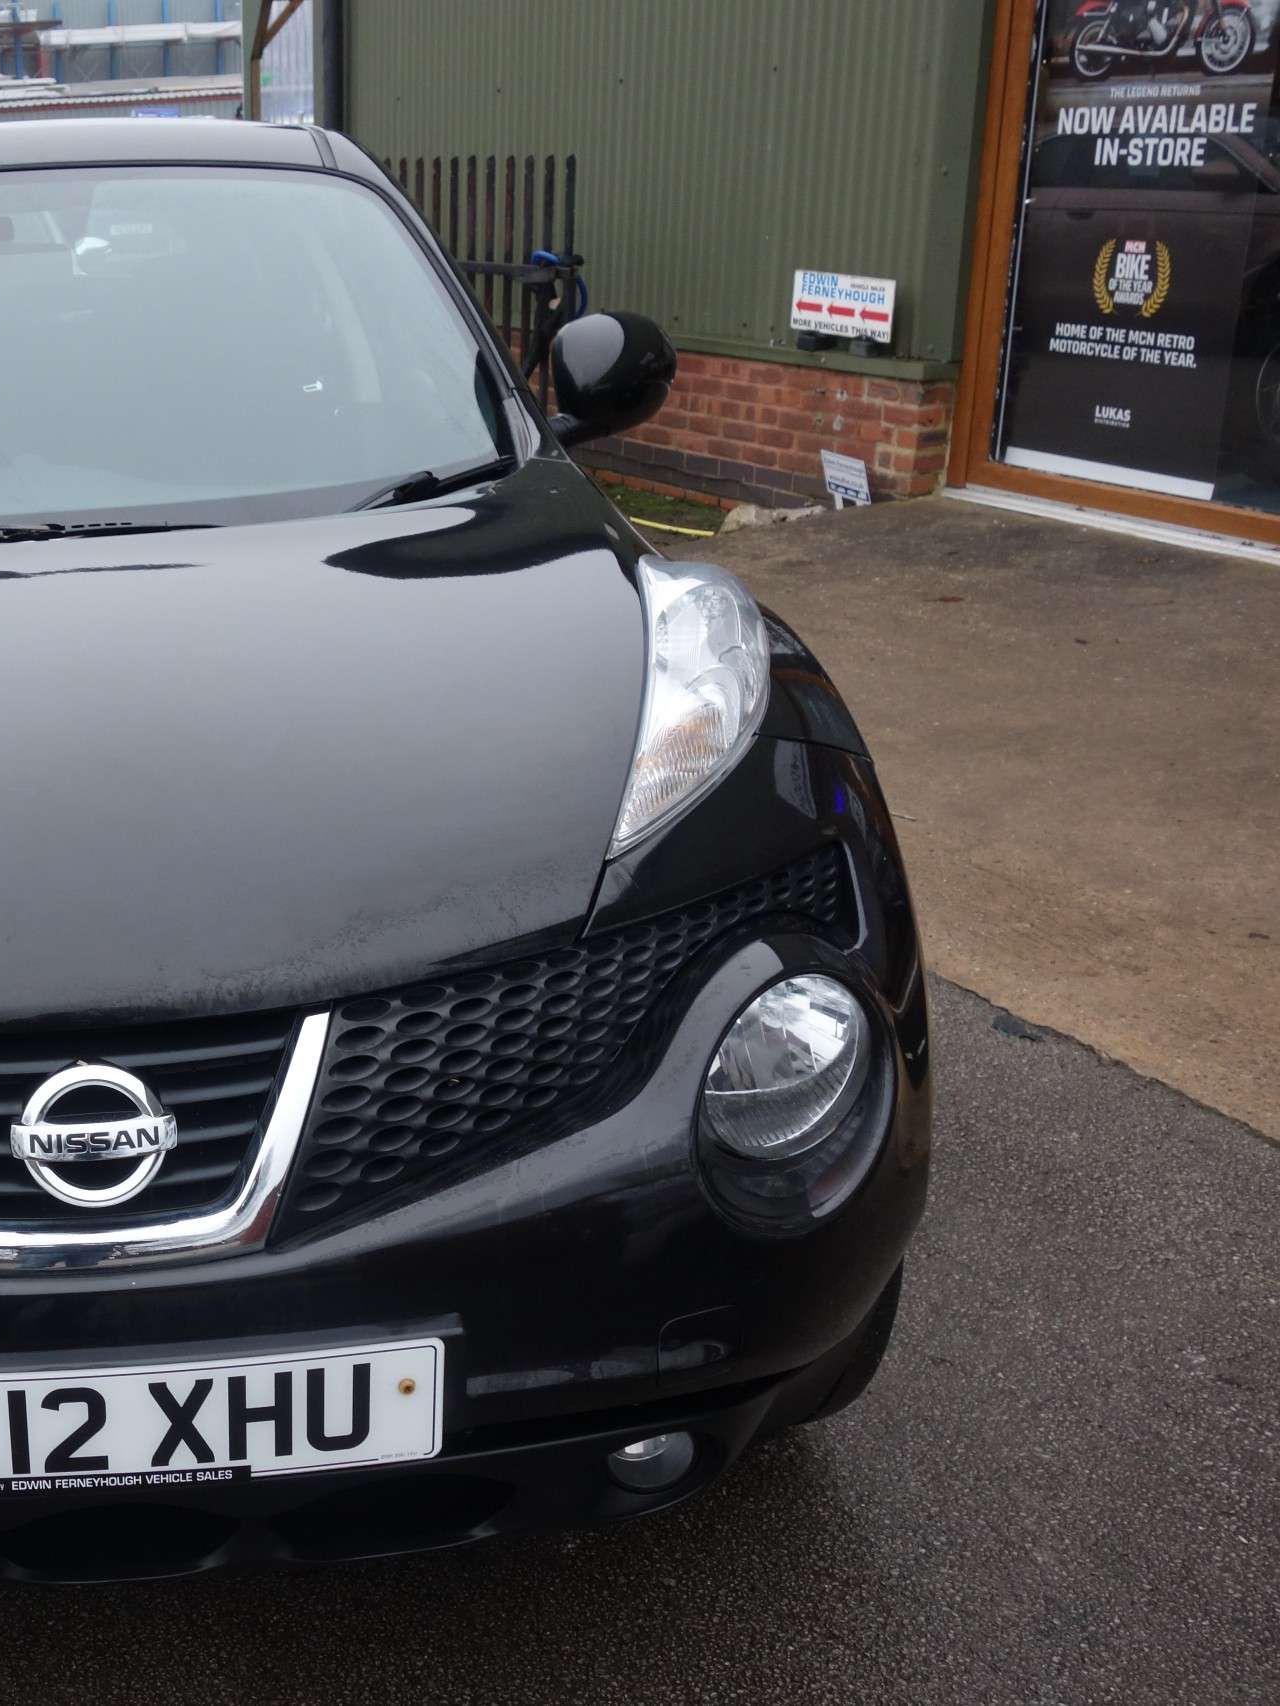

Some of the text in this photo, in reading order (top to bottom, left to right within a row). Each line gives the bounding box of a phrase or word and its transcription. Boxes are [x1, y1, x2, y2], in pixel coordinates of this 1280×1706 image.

[1110, 85, 1201, 98] THE LEGEND RETURNS
[1057, 103, 1257, 135] NOW AVAILABLE
[1094, 137, 1207, 167] IN-STORE
[1124, 241, 1146, 253] MCN
[1115, 252, 1151, 280] BIKE
[802, 272, 838, 287] EDWIN
[1108, 278, 1153, 294] OF THE YEAR
[801, 284, 885, 304] FERNEYHOUGH
[1114, 291, 1145, 305] AWARDS
[793, 317, 889, 340] MORE VEHICLES THIS WAY!
[1055, 322, 1195, 350] HOME OF THE MCN RETRO
[1049, 338, 1197, 369] MOTORCYCLE OF THE YEAR.
[1095, 405, 1131, 422] LUKAS
[29, 1125, 159, 1154] NISSAN
[148, 1362, 371, 1468] XHU
[11, 1479, 52, 1491] EDWIN
[55, 1475, 142, 1489] FERNEYHOUGH
[145, 1472, 193, 1485] VEHICLE
[196, 1470, 233, 1482] SALES
